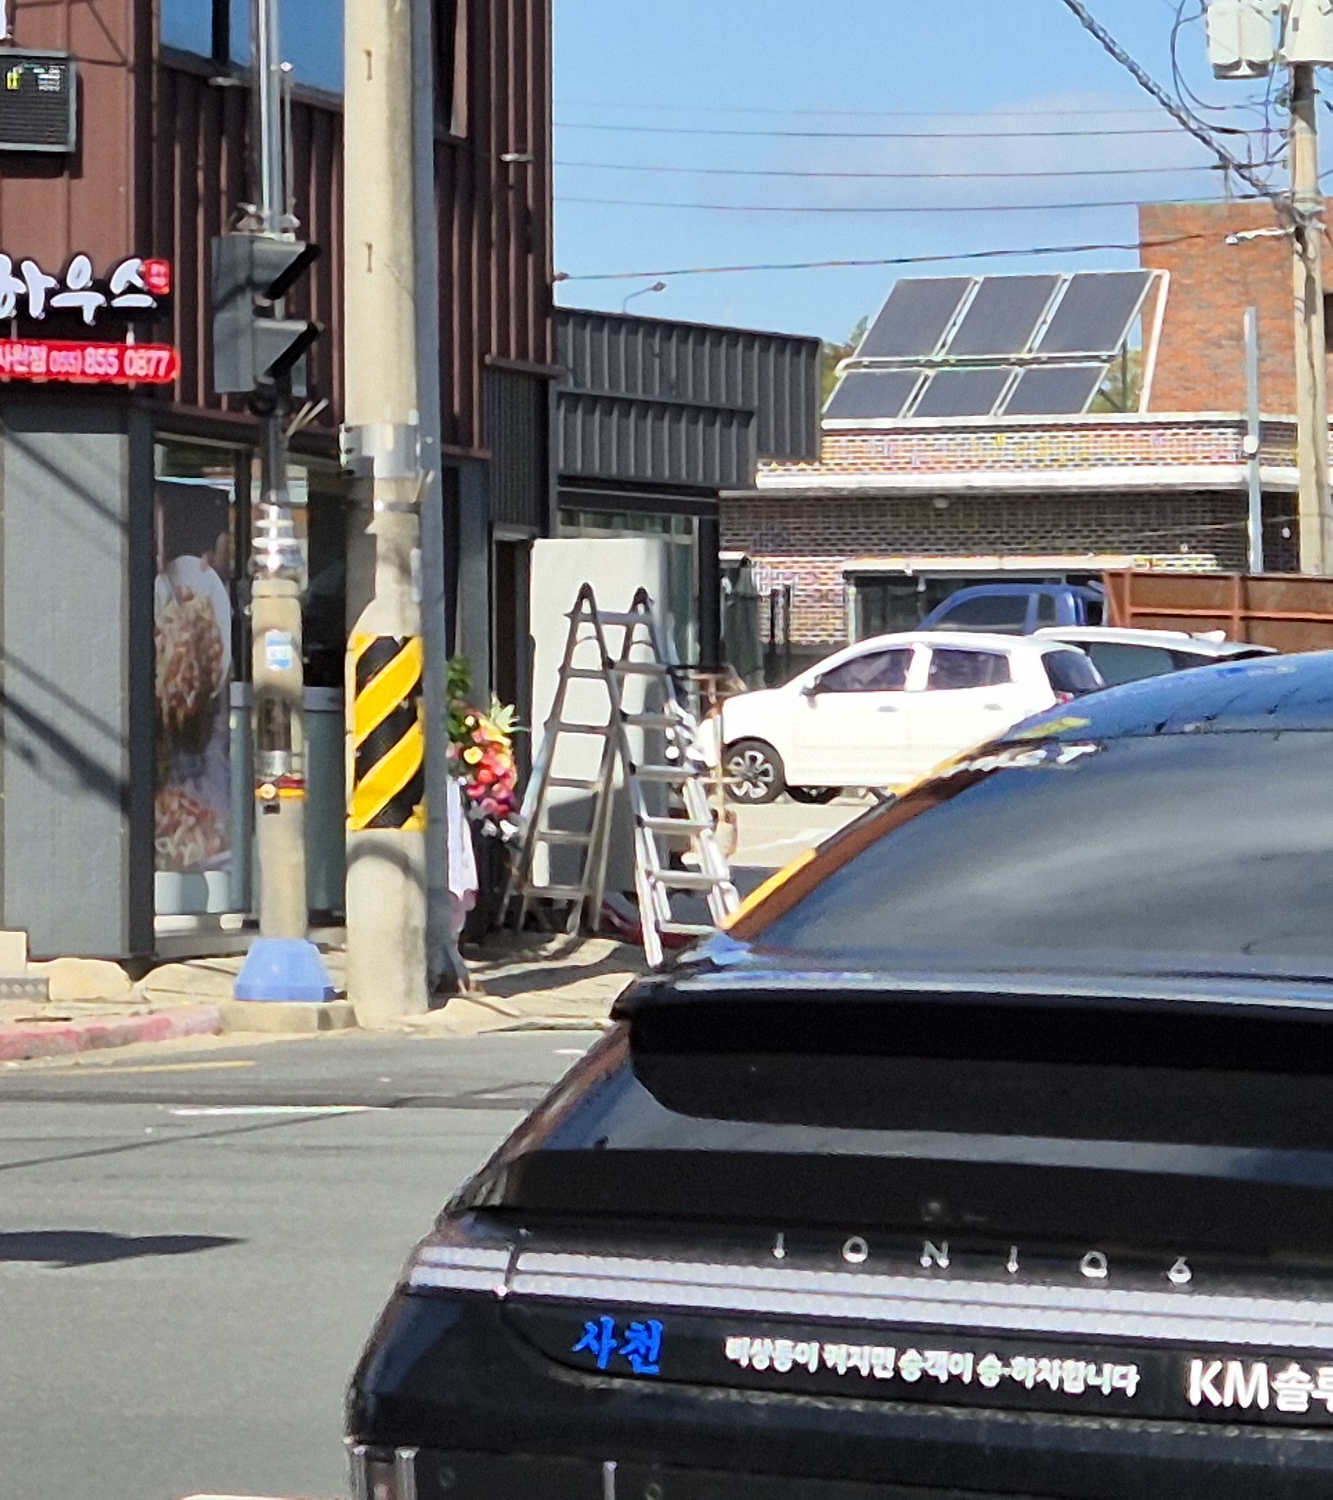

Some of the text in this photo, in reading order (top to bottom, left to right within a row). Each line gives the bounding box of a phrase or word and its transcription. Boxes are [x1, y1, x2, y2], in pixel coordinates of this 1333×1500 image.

[773, 1231, 1110, 1280] IONIQ
[570, 1314, 664, 1375] 사천
[897, 1348, 975, 1384] 승객이
